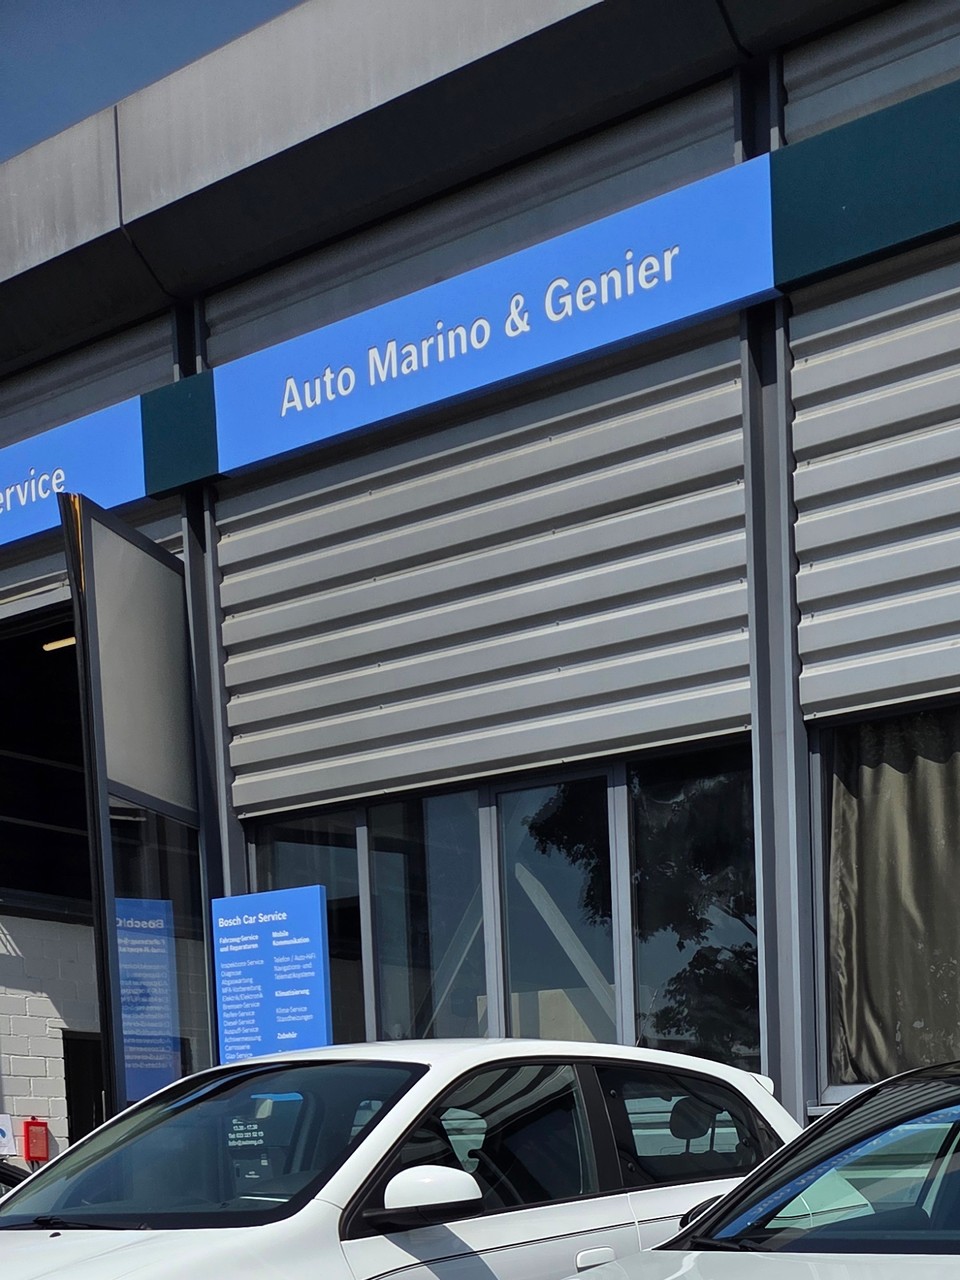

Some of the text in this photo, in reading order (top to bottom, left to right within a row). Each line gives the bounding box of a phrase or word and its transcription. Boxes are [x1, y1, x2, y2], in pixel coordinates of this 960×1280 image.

[281, 244, 680, 418] Auto Marino & Genier
[0, 468, 66, 514] rvice
[219, 911, 288, 927] Bosch Car Service
